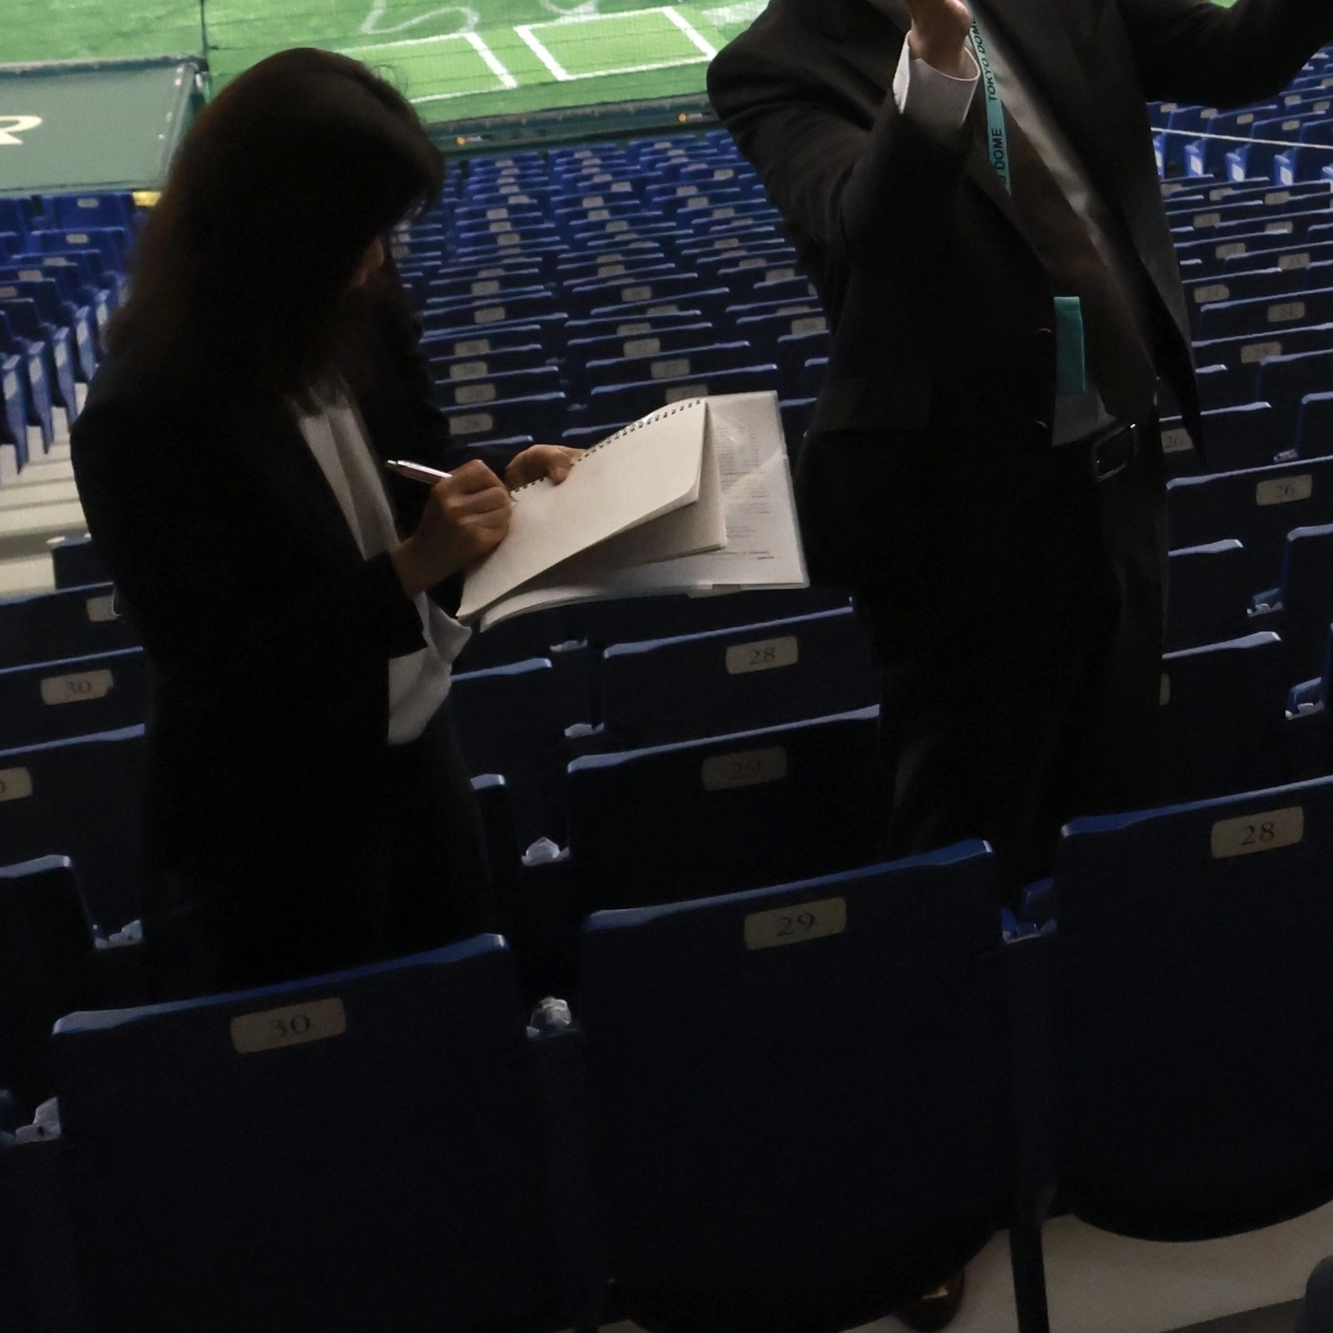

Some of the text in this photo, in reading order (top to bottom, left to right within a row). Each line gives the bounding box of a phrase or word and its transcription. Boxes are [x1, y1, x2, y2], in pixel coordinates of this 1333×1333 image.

[990, 127, 1006, 171] DOME
[1274, 484, 1295, 497] 26
[748, 646, 777, 664] 28
[1241, 823, 1274, 844] 28
[777, 913, 816, 937] 29
[268, 1014, 310, 1044] 30
